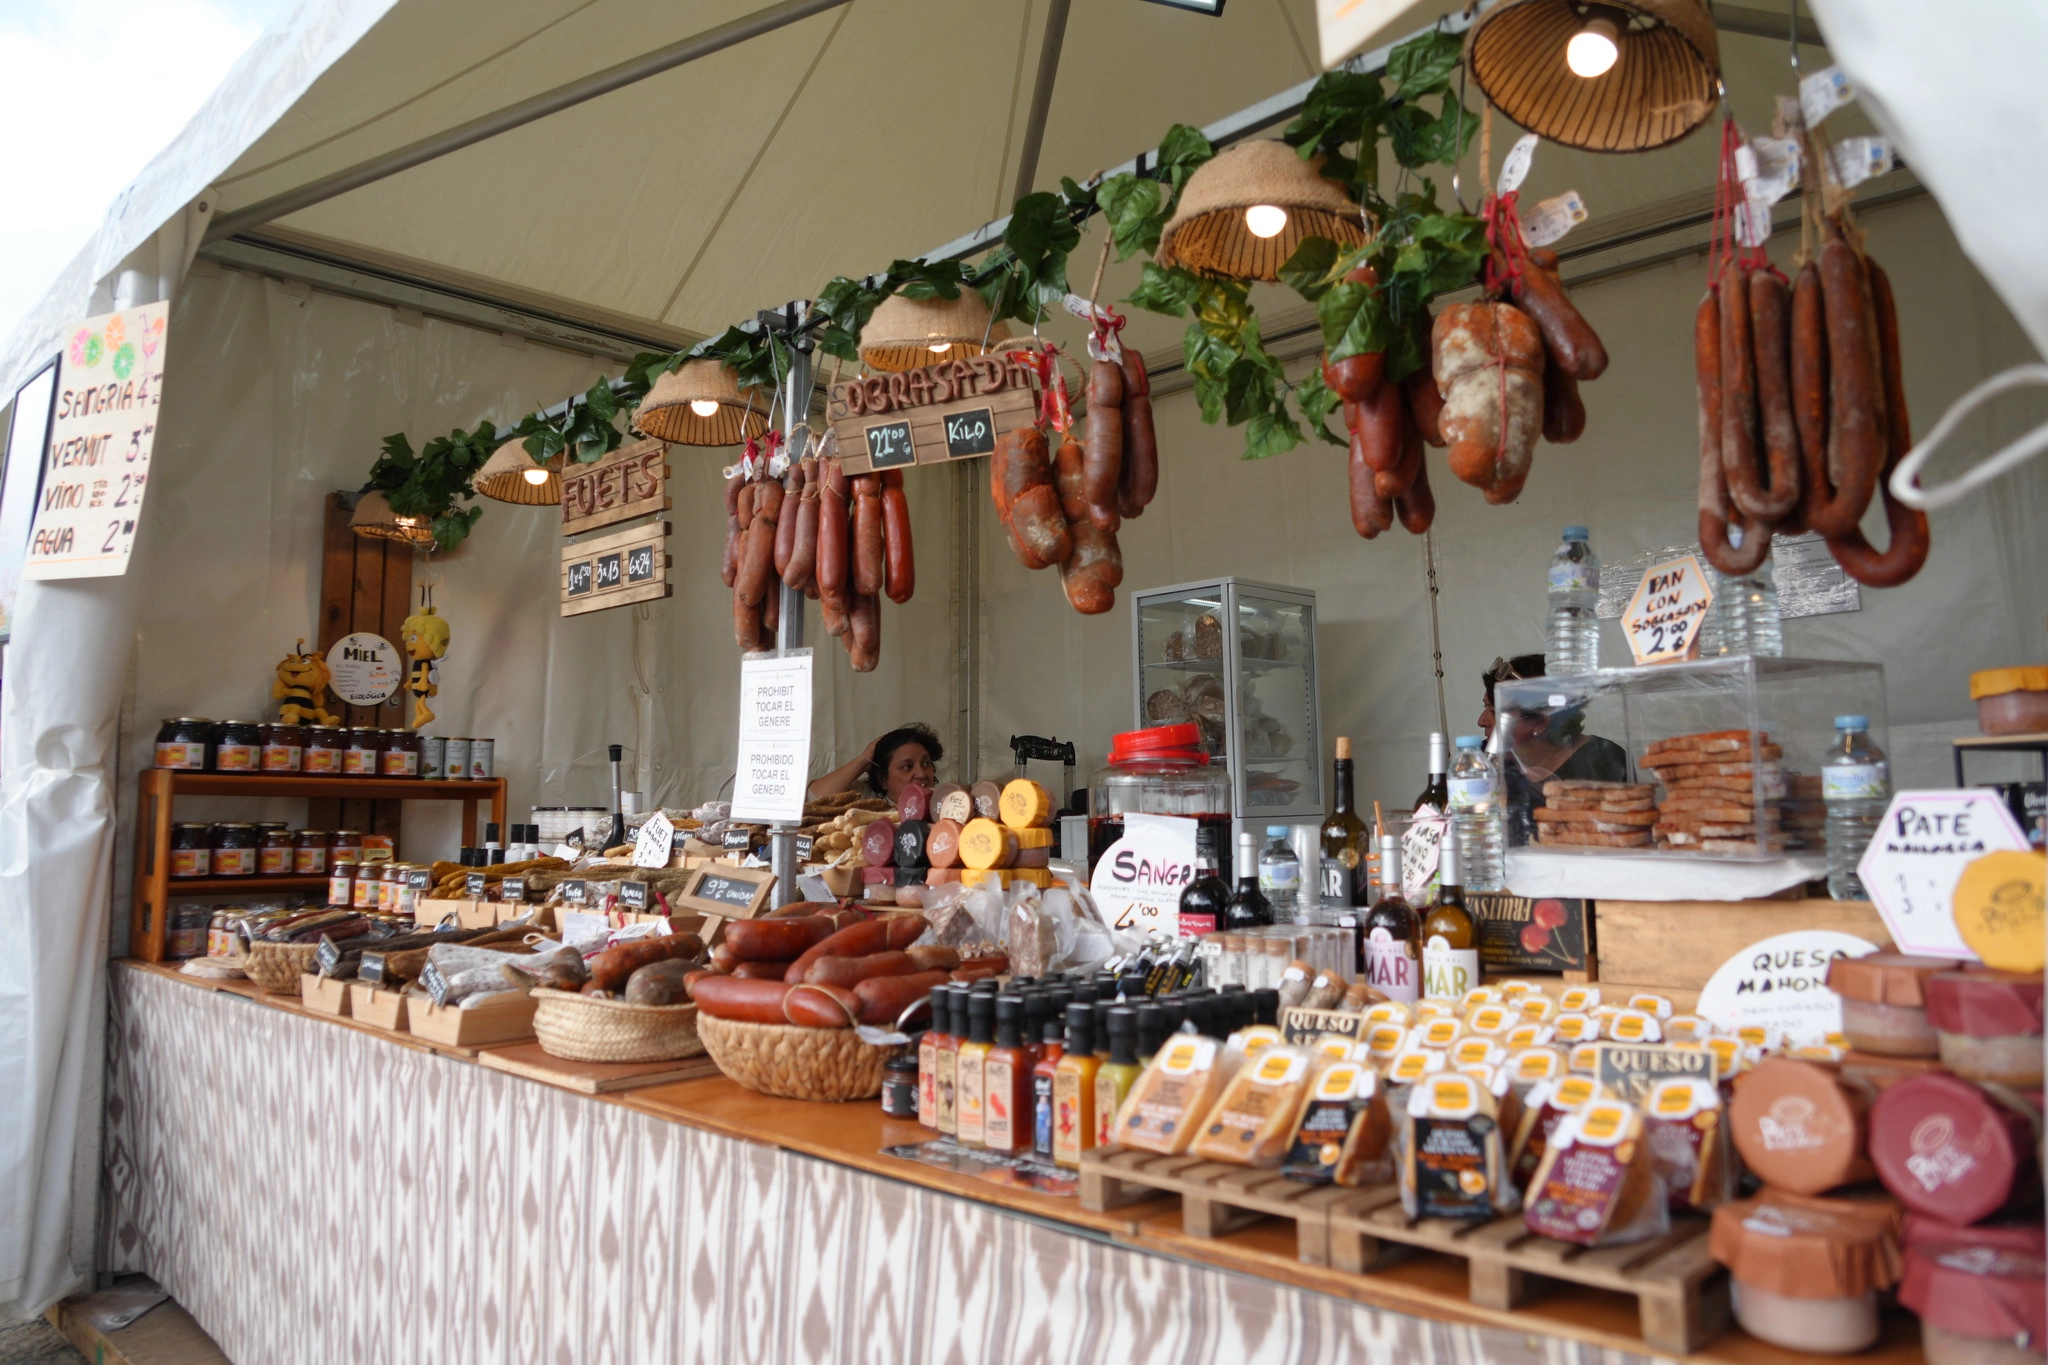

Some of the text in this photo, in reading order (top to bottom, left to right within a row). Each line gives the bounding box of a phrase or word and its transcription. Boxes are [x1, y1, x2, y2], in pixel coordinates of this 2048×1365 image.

[52, 433, 112, 469] VERMUT
[562, 451, 660, 522] FUETS
[31, 527, 74, 555] AGUA
[1650, 567, 1684, 594] PAN
[1646, 590, 1681, 613] CON
[757, 685, 794, 697] PROHIBIT
[756, 701, 795, 712] TOCAR EL
[750, 754, 794, 765] PROHIBIDO
[751, 769, 790, 780] TOCAR EL
[652, 818, 669, 841] FUET
[1896, 799, 1975, 837] PATÉ
[1111, 850, 1197, 886] SANGR
[1320, 868, 1343, 898] AR
[1365, 955, 1409, 987] MAR
[1424, 963, 1468, 997] MAR
[1289, 1012, 1354, 1033] QUESO
[1608, 1049, 1704, 1073] QUESO
